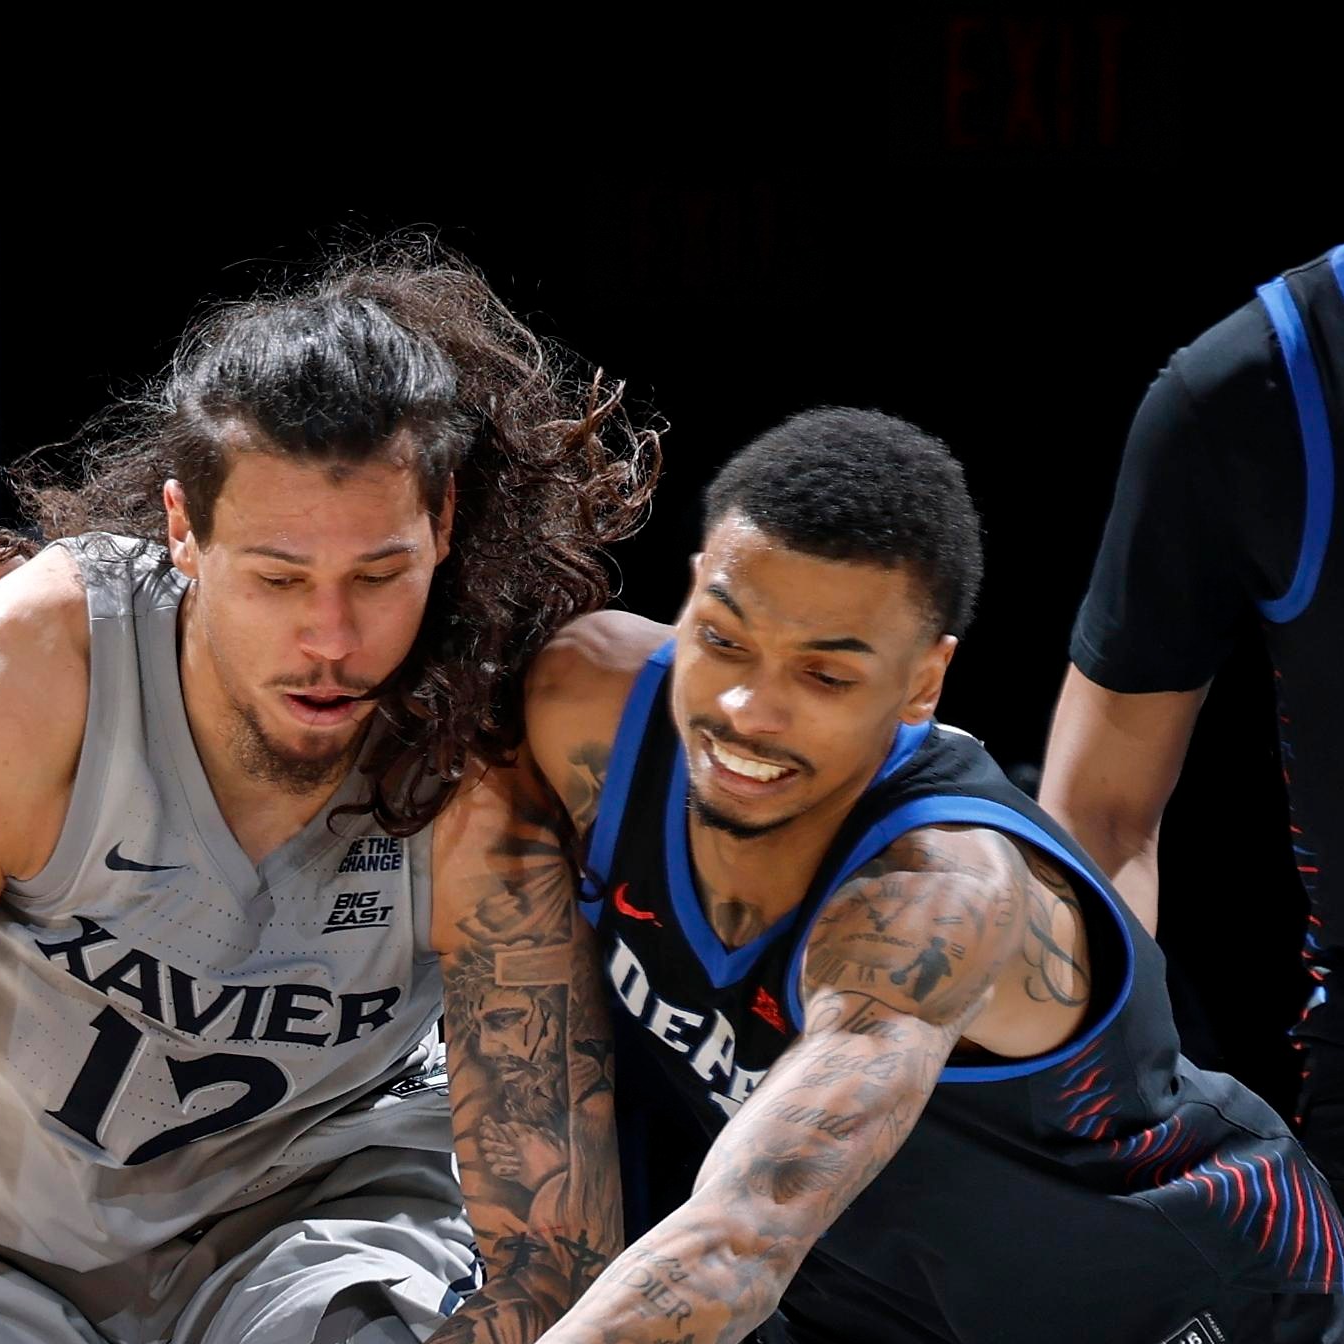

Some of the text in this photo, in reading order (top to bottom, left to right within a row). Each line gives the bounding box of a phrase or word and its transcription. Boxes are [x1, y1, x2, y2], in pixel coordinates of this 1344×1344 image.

[368, 836, 399, 855] THE
[338, 853, 402, 873] CHANGE
[334, 891, 381, 909] BIG
[327, 905, 394, 925] EAST
[35, 915, 401, 1047] XAVIER
[45, 1004, 292, 1166] 12
